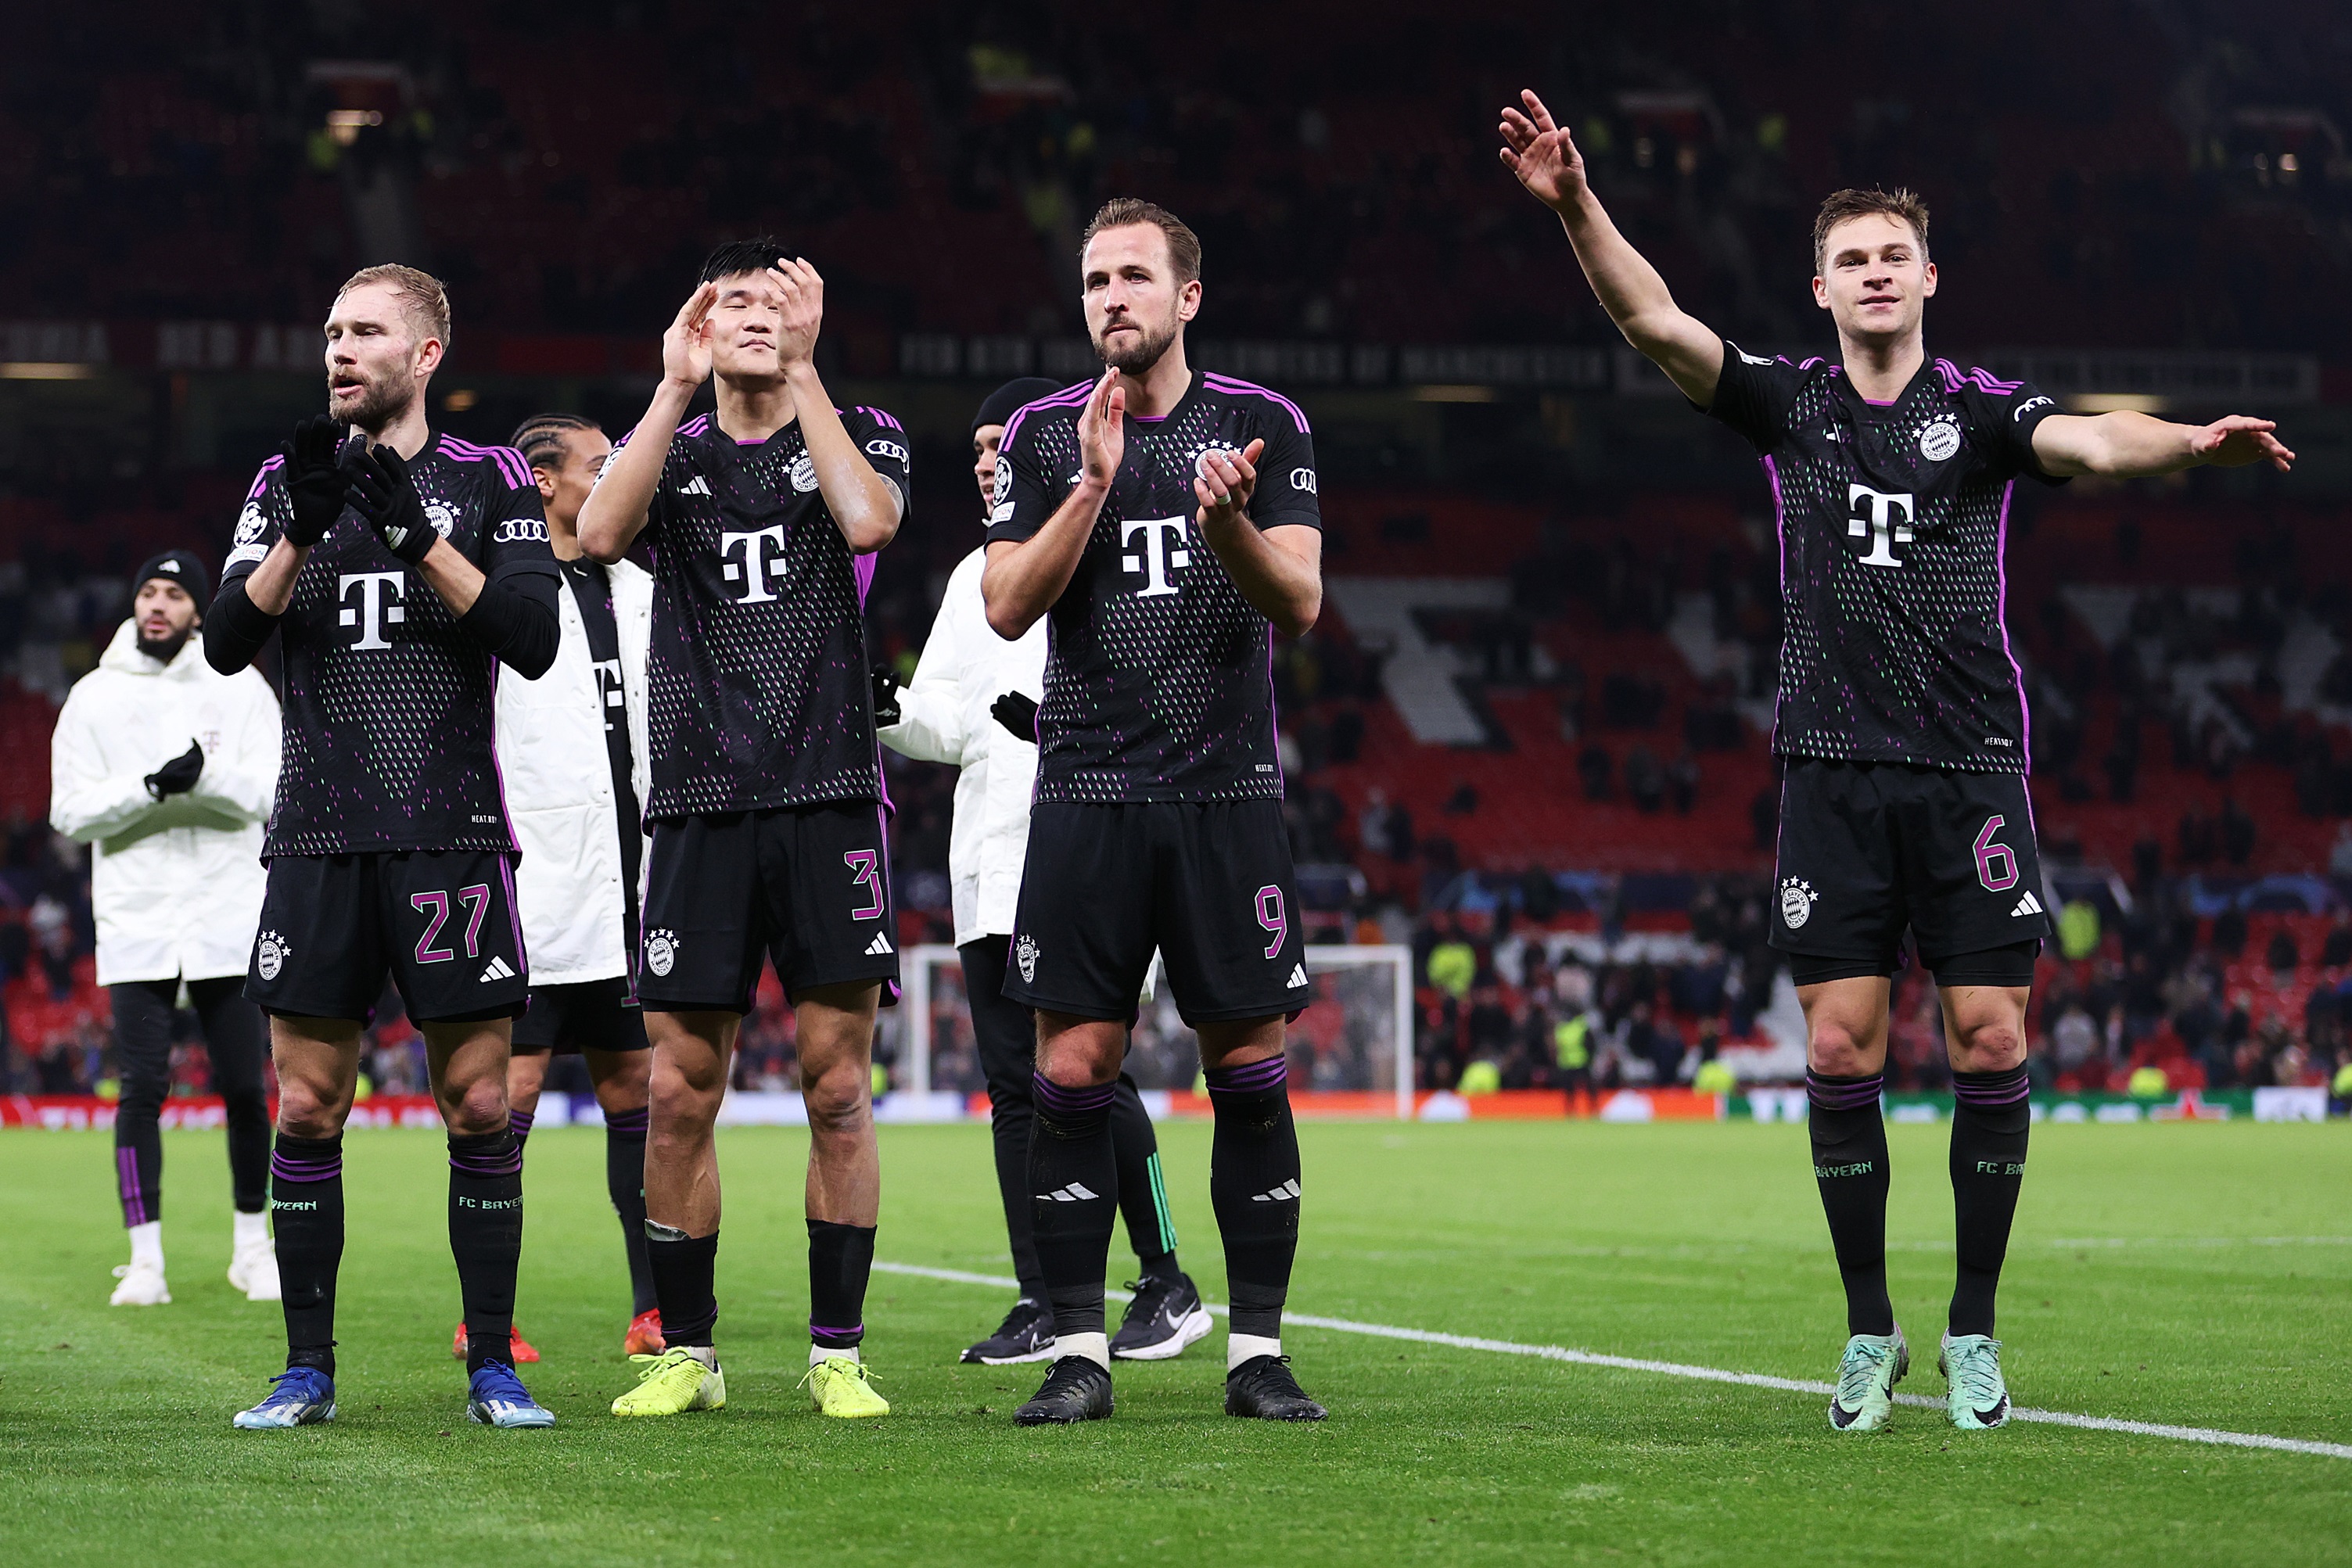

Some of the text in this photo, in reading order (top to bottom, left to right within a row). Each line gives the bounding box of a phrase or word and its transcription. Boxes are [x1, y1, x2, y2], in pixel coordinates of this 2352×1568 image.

[1930, 425, 1955, 438] BAYERN
[1121, 515, 1190, 598] T
[1847, 483, 1914, 567] T
[721, 524, 788, 604] T
[339, 571, 404, 651] T
[844, 849, 885, 921] 3
[1972, 814, 2020, 892] 6
[411, 883, 490, 964] 27
[1254, 884, 1287, 960] 9
[458, 1195, 522, 1210] FC BAYER
[1815, 1161, 1874, 1179] BAYERN
[1977, 1161, 1998, 1174] FC
